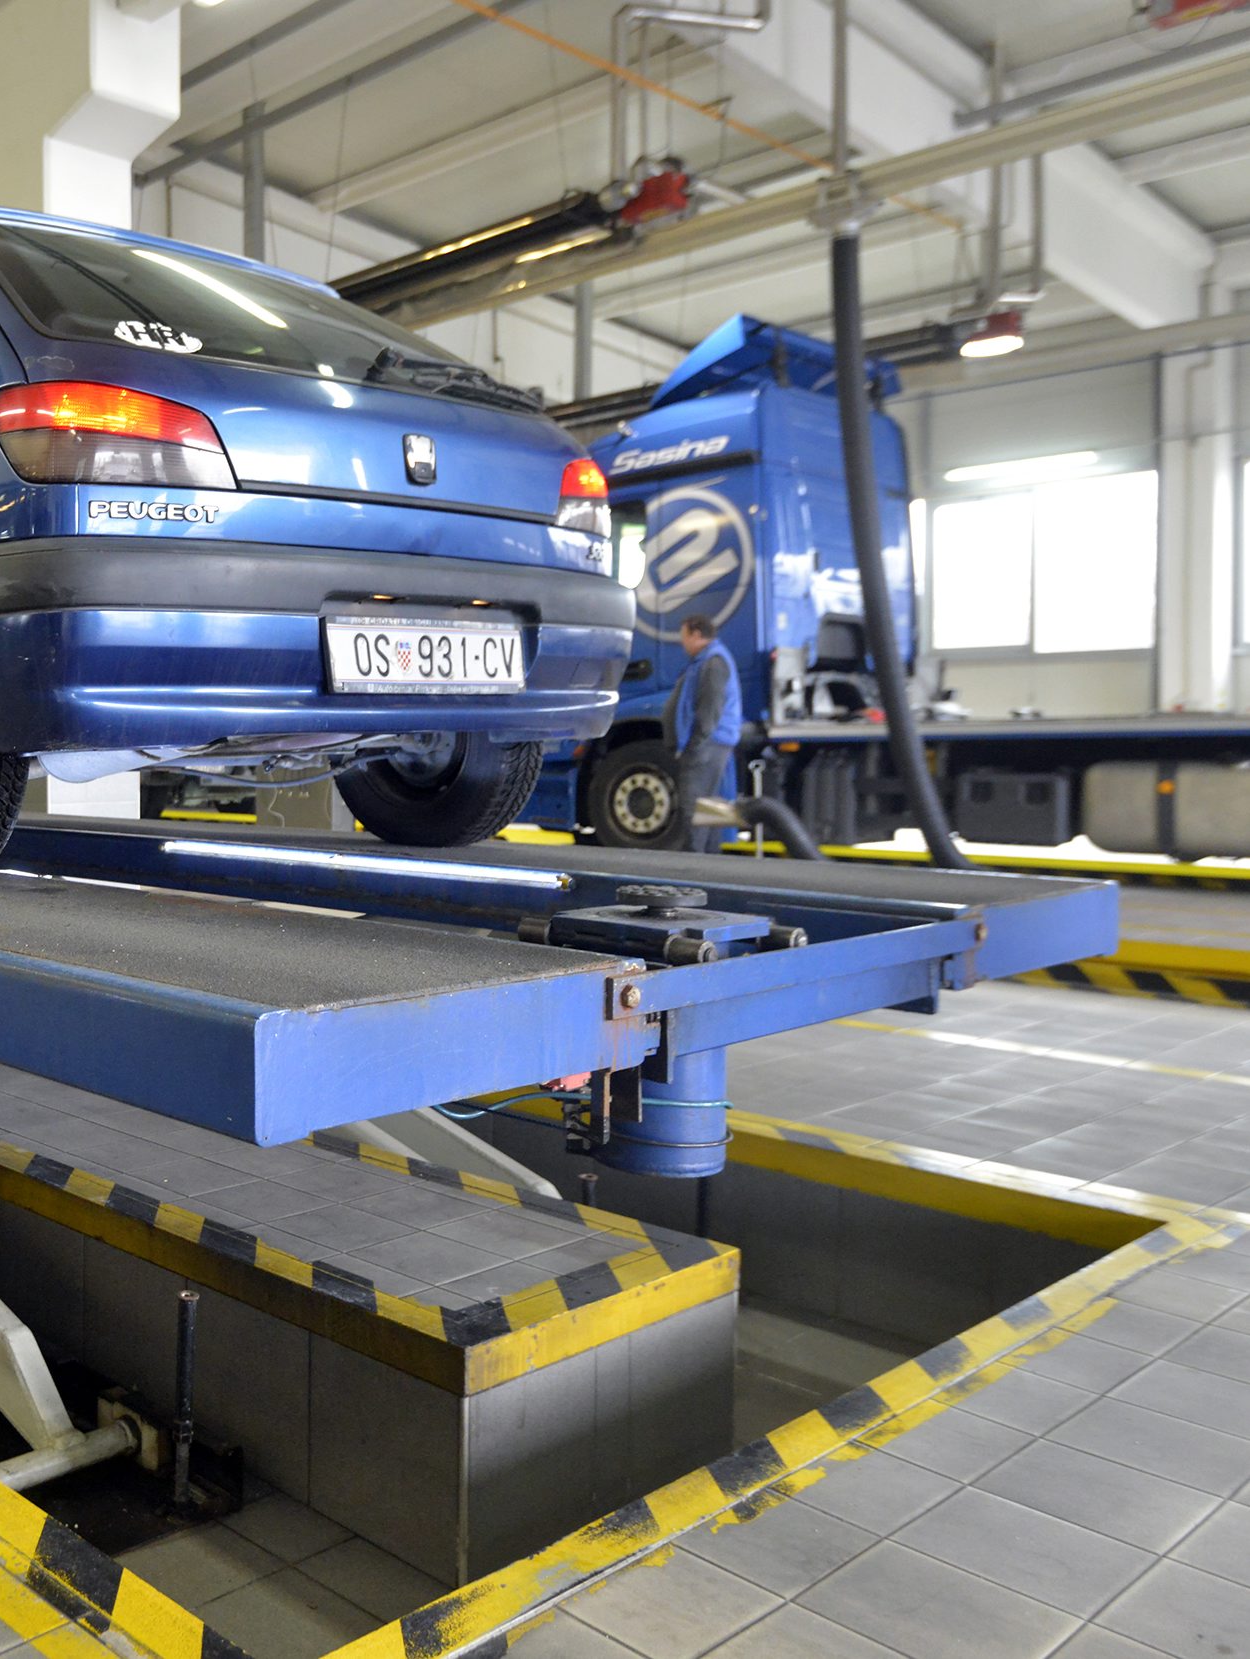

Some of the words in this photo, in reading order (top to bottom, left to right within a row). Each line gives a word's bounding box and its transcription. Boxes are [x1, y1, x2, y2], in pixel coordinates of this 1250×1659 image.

[609, 435, 730, 475] Sasina
[89, 500, 219, 523] PEUGEOT
[354, 632, 390, 677] OS
